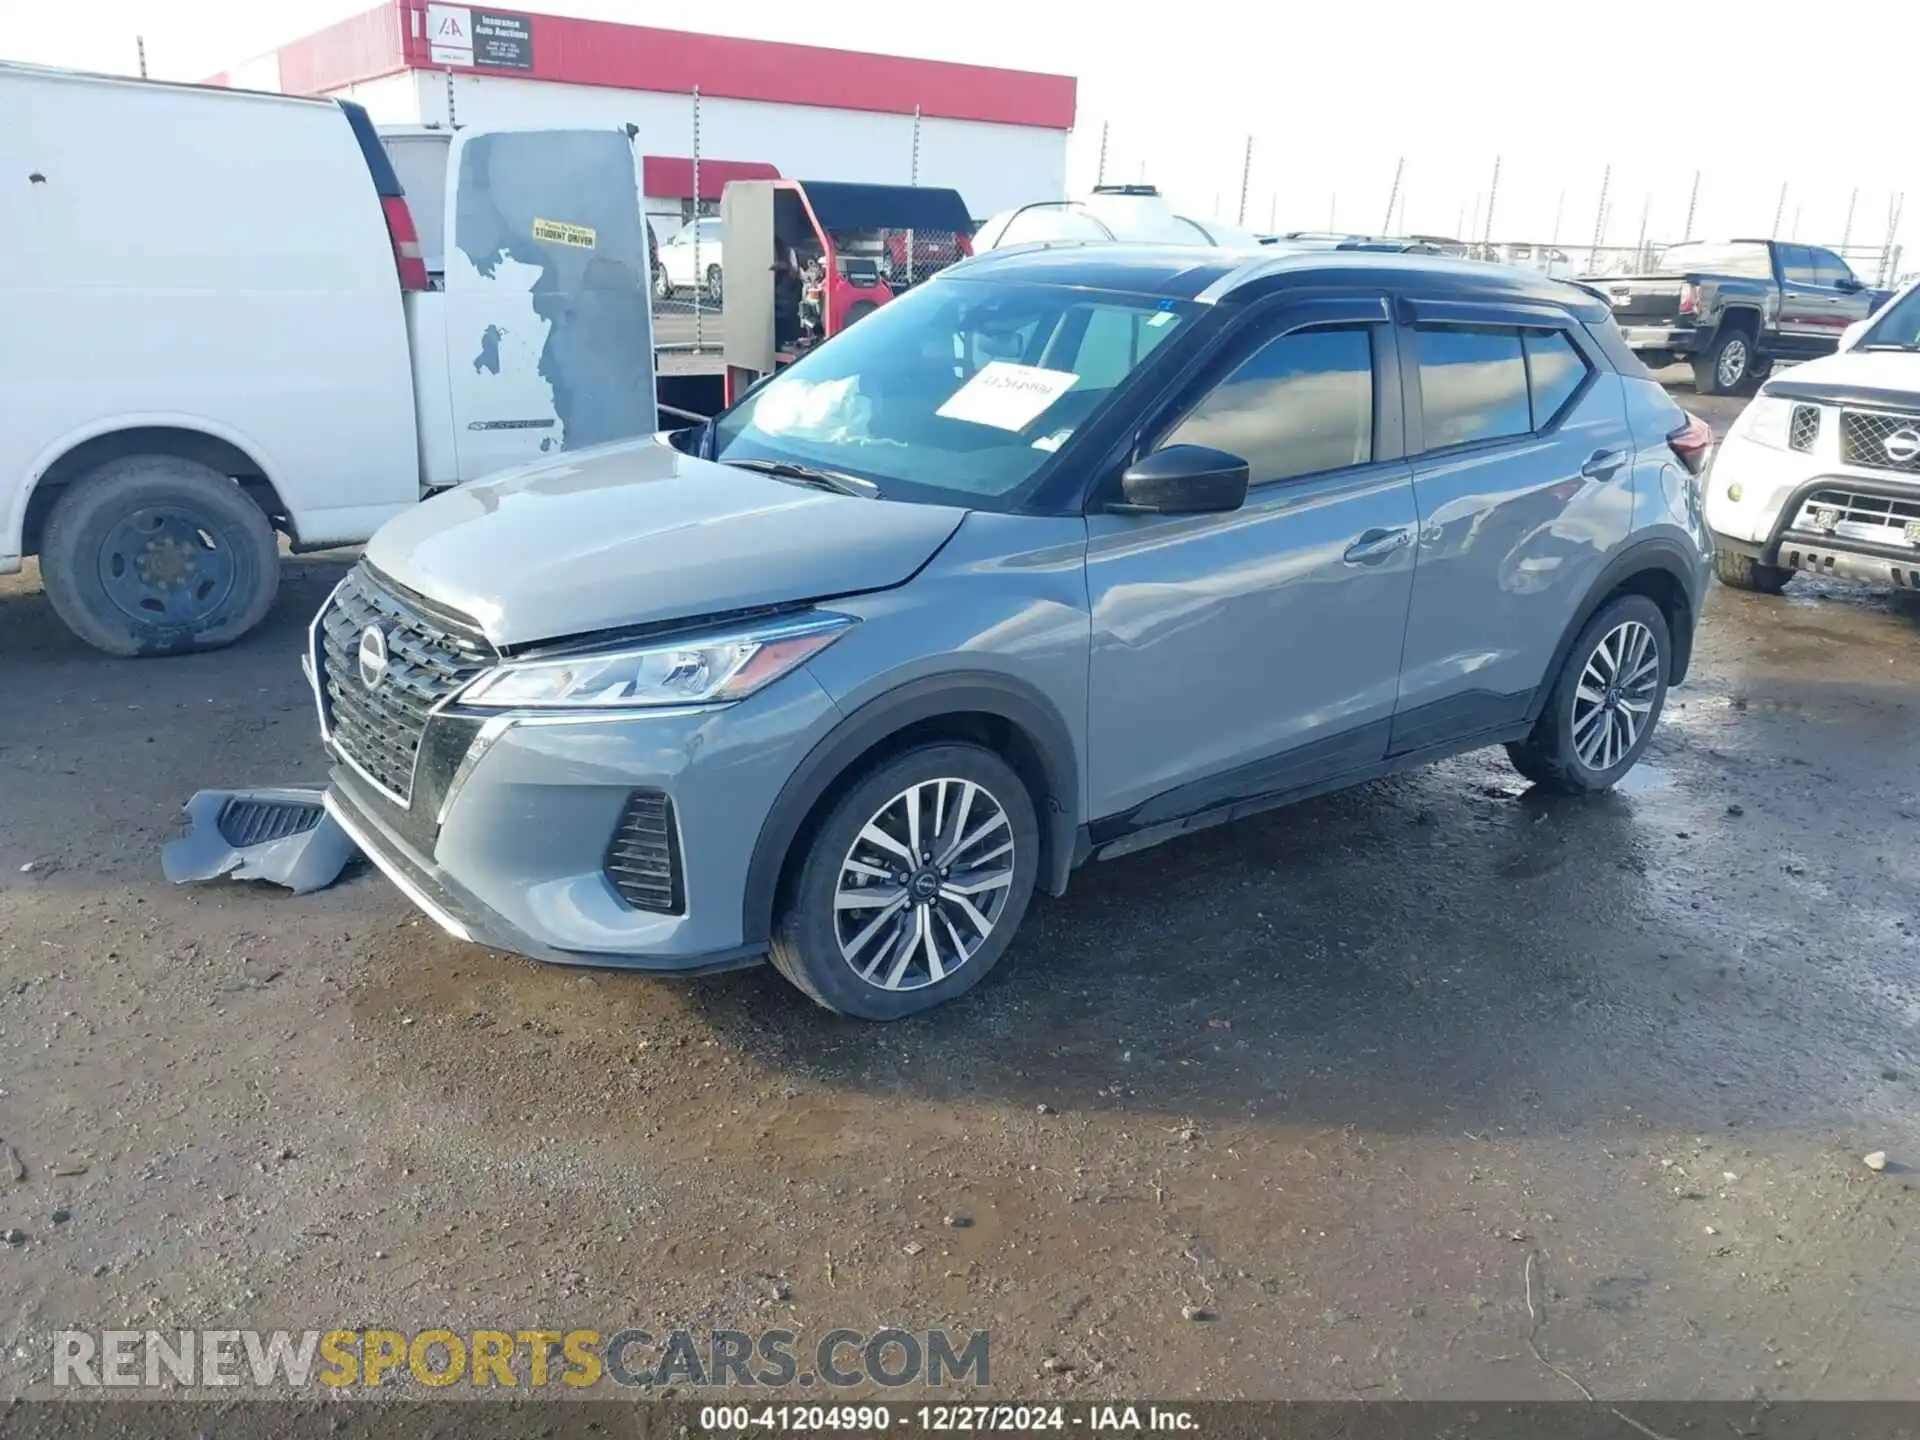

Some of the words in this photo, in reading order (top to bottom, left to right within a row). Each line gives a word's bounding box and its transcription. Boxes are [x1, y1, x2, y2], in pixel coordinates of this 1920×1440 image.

[475, 24, 493, 36] Auto
[495, 27, 528, 40] Auctions
[535, 227, 565, 241] STUDENT
[567, 233, 593, 246] DRIVER
